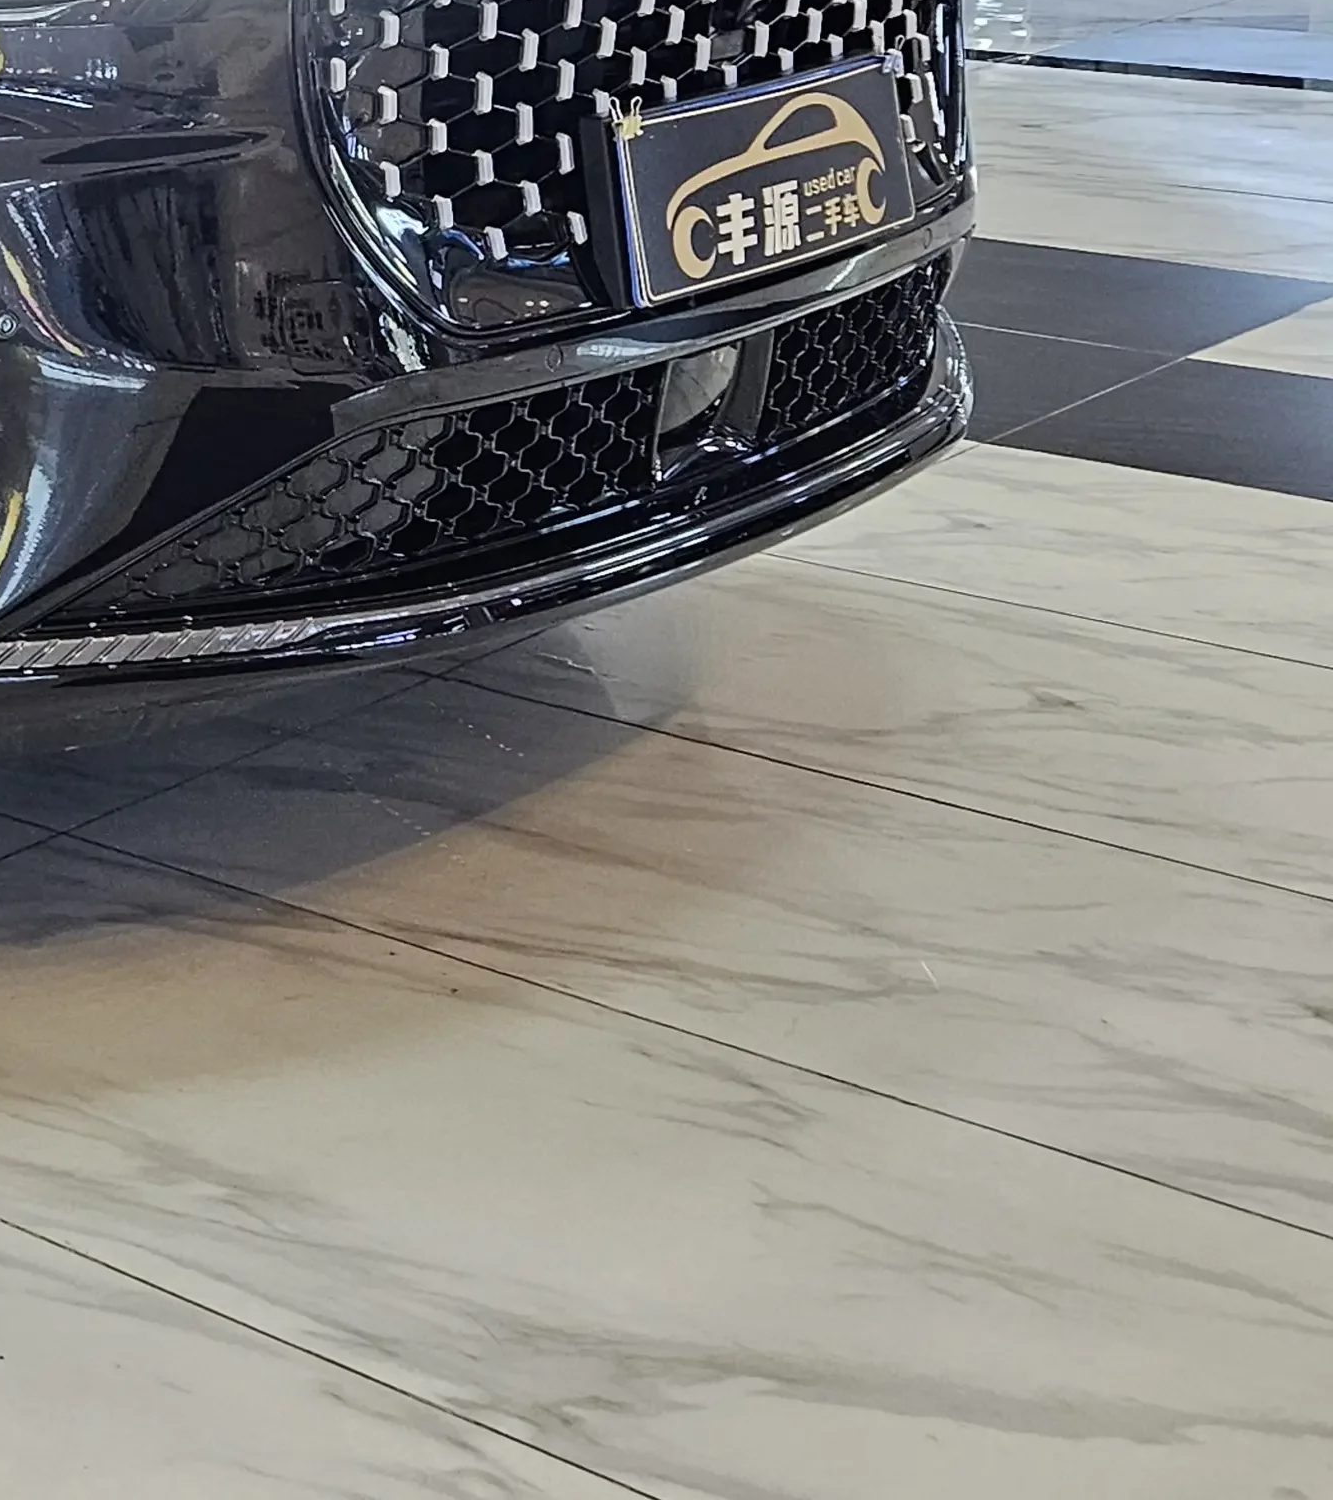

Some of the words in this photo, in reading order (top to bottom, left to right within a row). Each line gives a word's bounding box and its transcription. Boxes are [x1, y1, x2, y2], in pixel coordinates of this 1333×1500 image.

[803, 167, 836, 197] used
[837, 165, 857, 187] car
[716, 181, 801, 265] 丰源
[806, 192, 860, 242] 二手车
